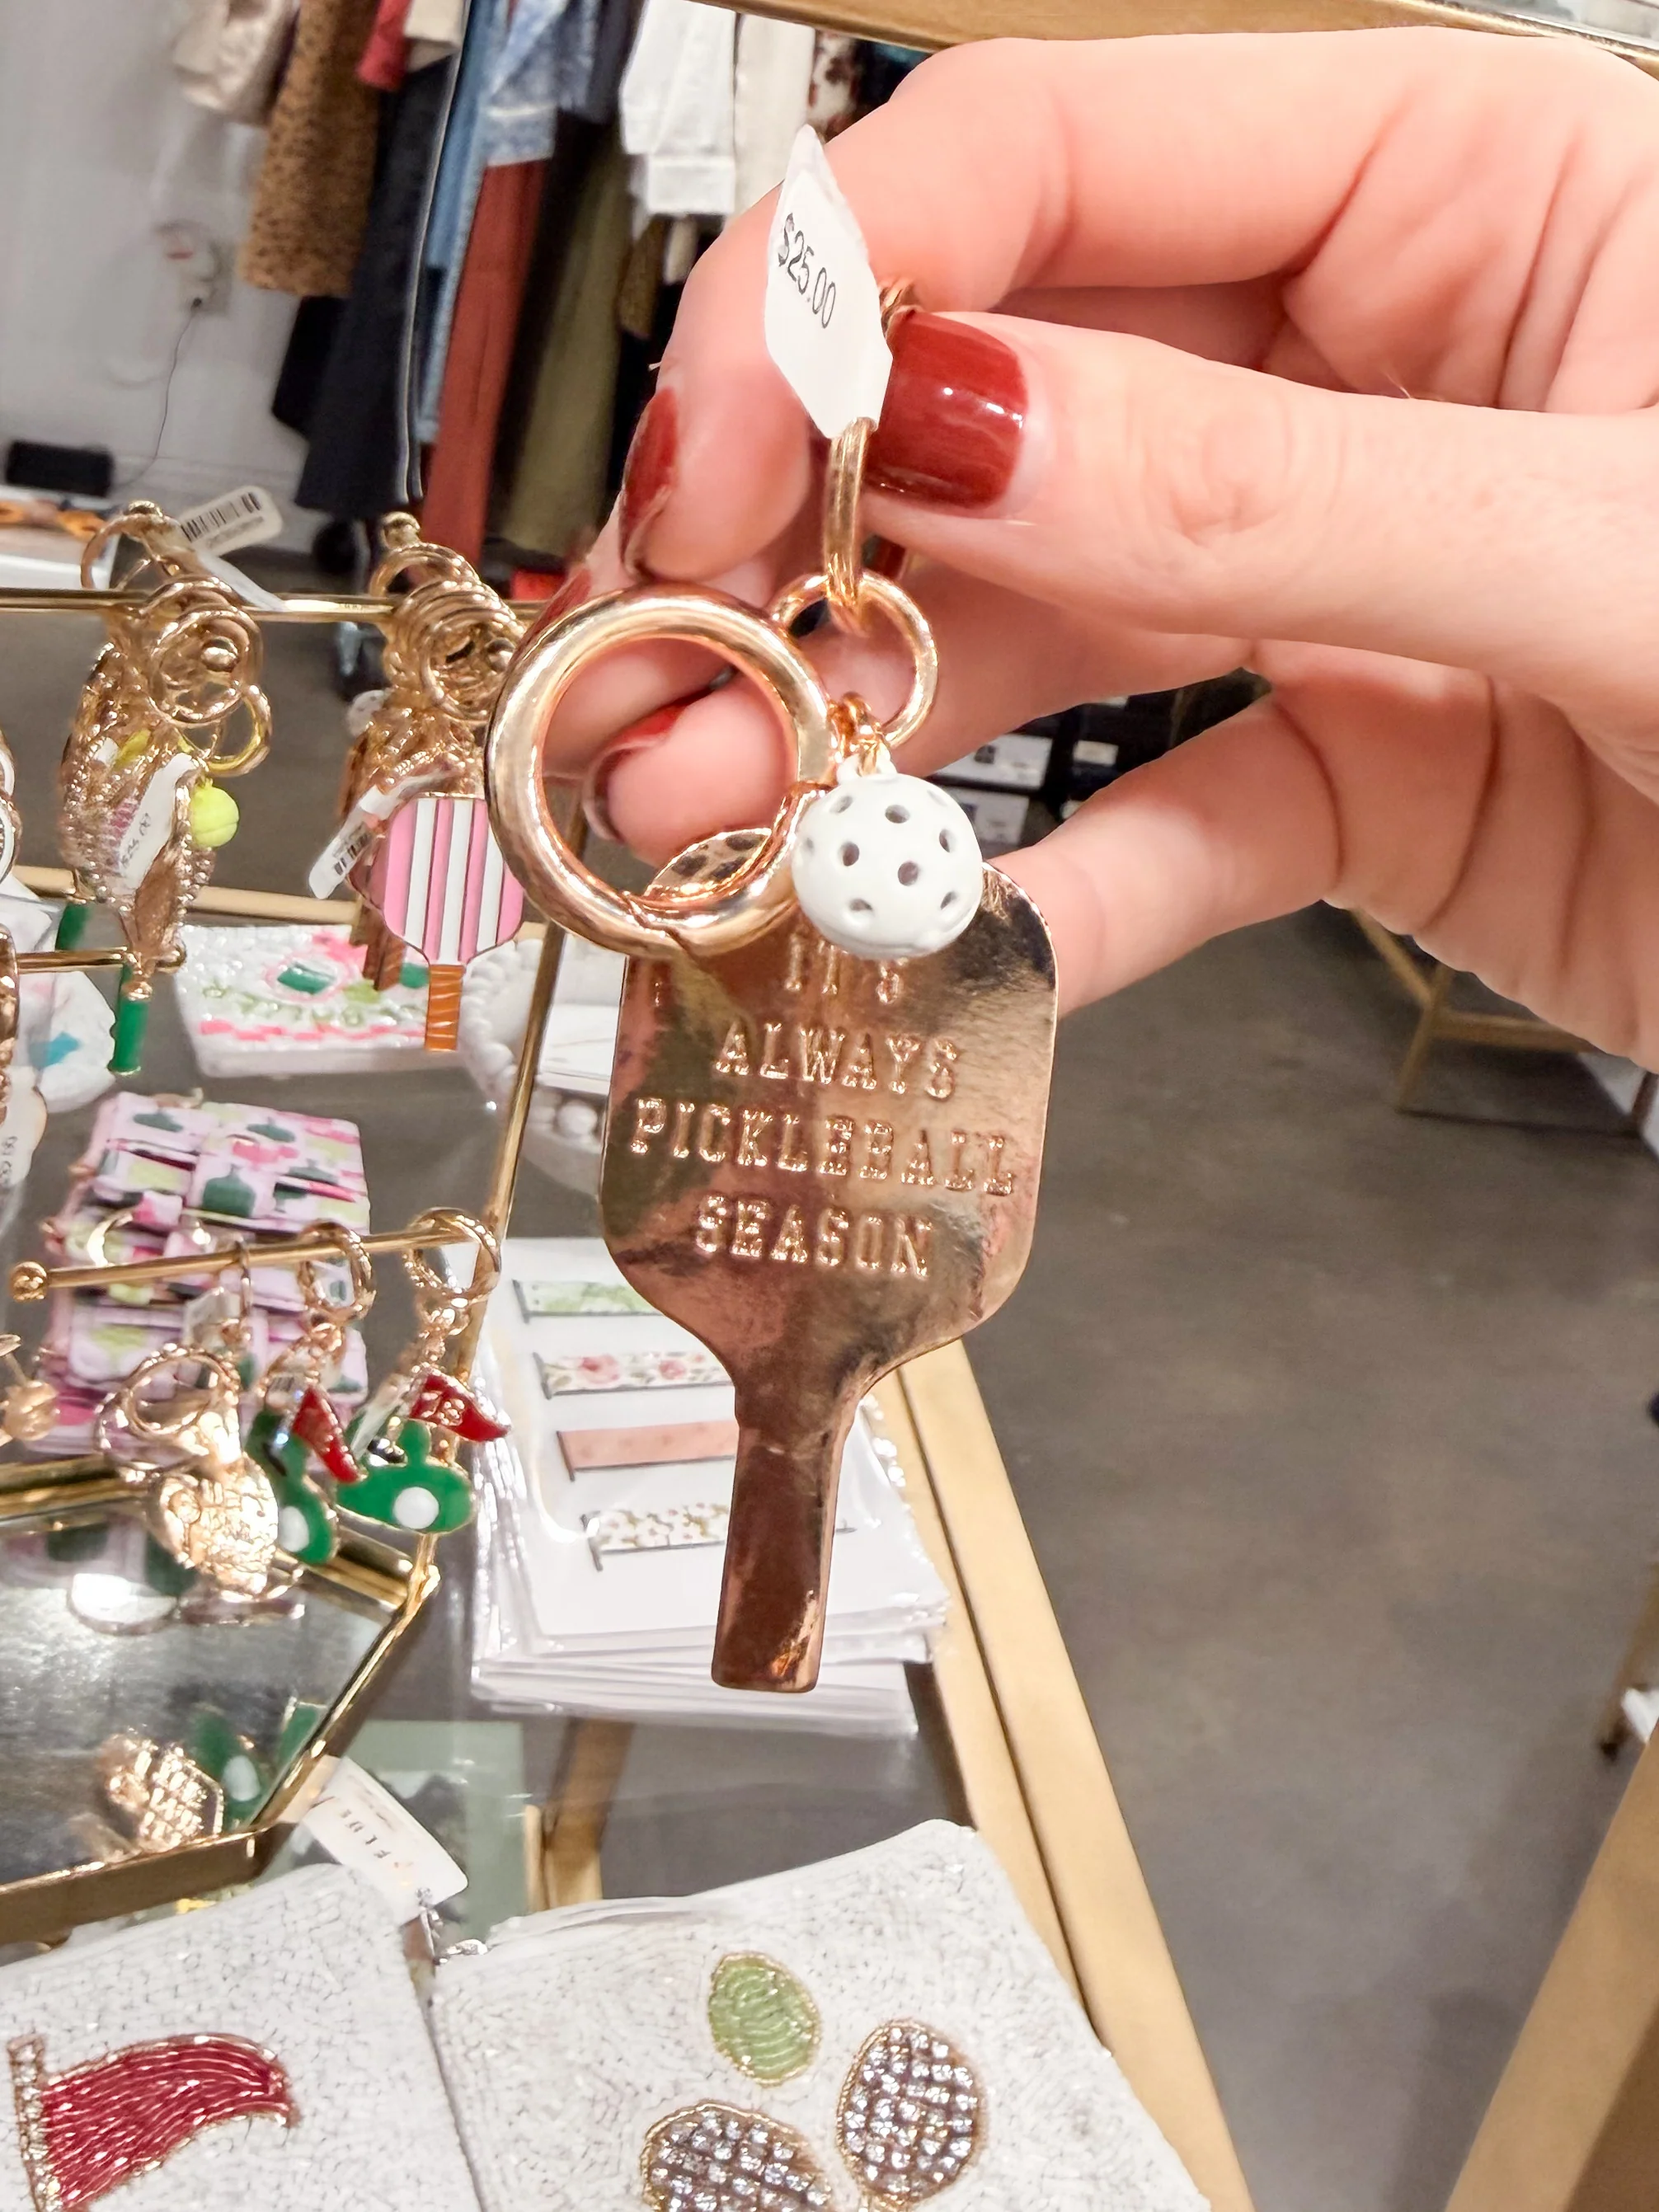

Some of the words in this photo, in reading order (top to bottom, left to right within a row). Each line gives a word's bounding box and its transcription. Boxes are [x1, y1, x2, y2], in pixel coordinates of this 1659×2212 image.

[778, 213, 836, 329] $25.00
[715, 1021, 959, 1101] ALWAYS
[630, 1097, 1017, 1197] PICKLEBALL
[695, 1195, 935, 1280] SEASON
